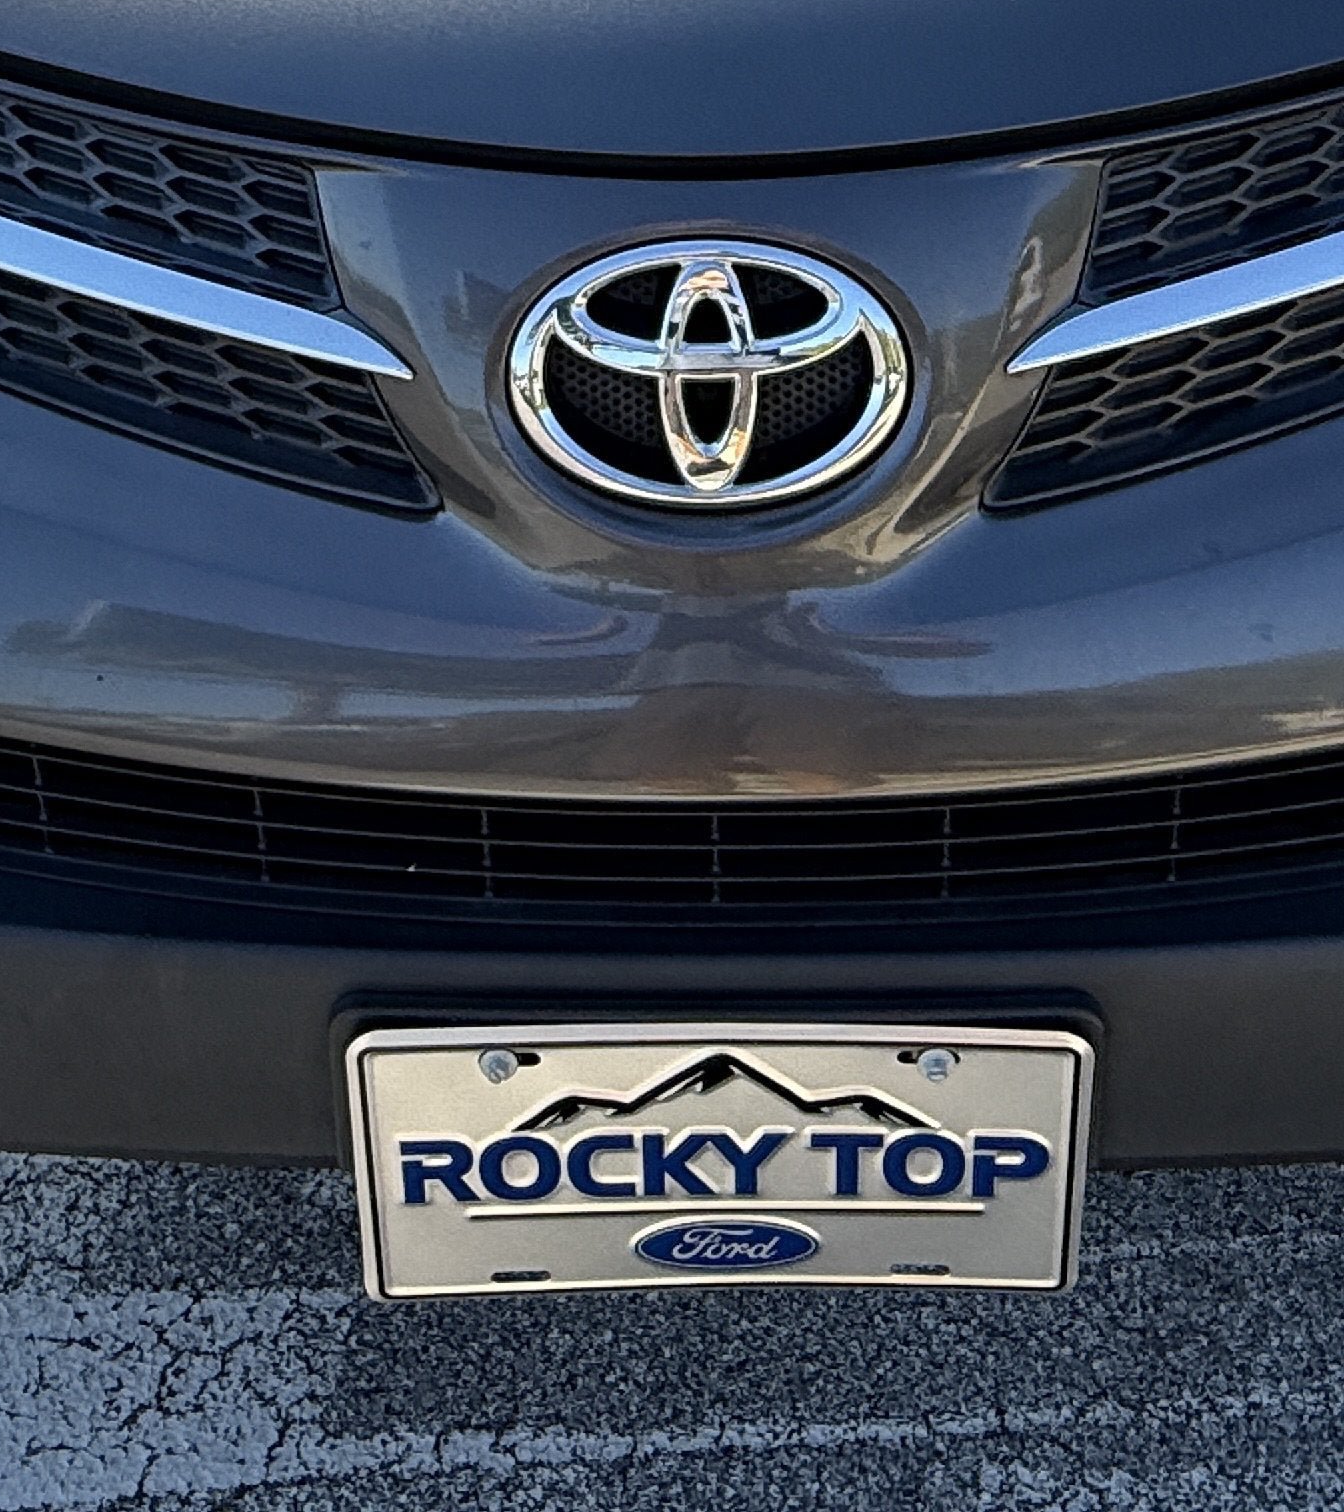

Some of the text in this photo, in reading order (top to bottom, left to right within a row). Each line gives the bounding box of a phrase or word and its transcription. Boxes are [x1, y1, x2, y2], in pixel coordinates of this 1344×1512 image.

[397, 1128, 1051, 1205] ROCKY TOP
[671, 1227, 781, 1260] Ford
